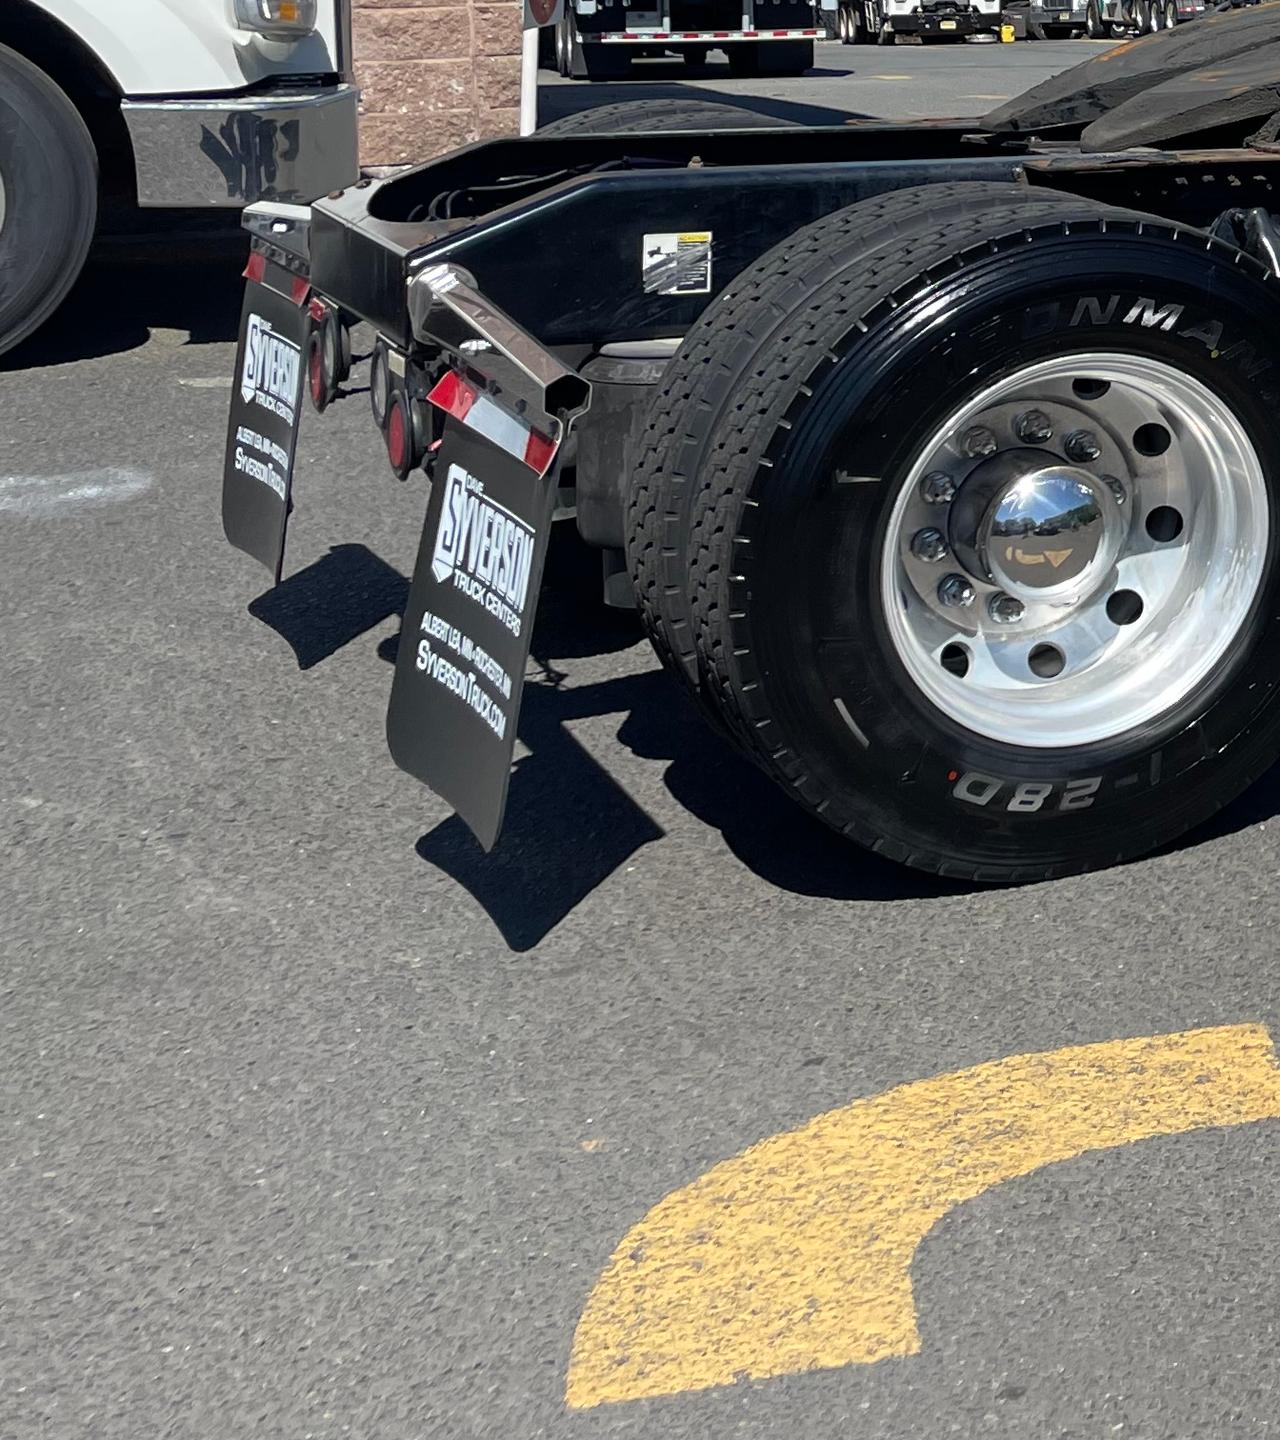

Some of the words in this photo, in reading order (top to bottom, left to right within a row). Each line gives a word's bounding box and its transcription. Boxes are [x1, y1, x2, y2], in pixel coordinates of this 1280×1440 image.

[438, 474, 534, 613] SYVERSON
[420, 611, 450, 643] ALBERT
[454, 569, 487, 606] TRUCK
[485, 592, 521, 638] CENTERS
